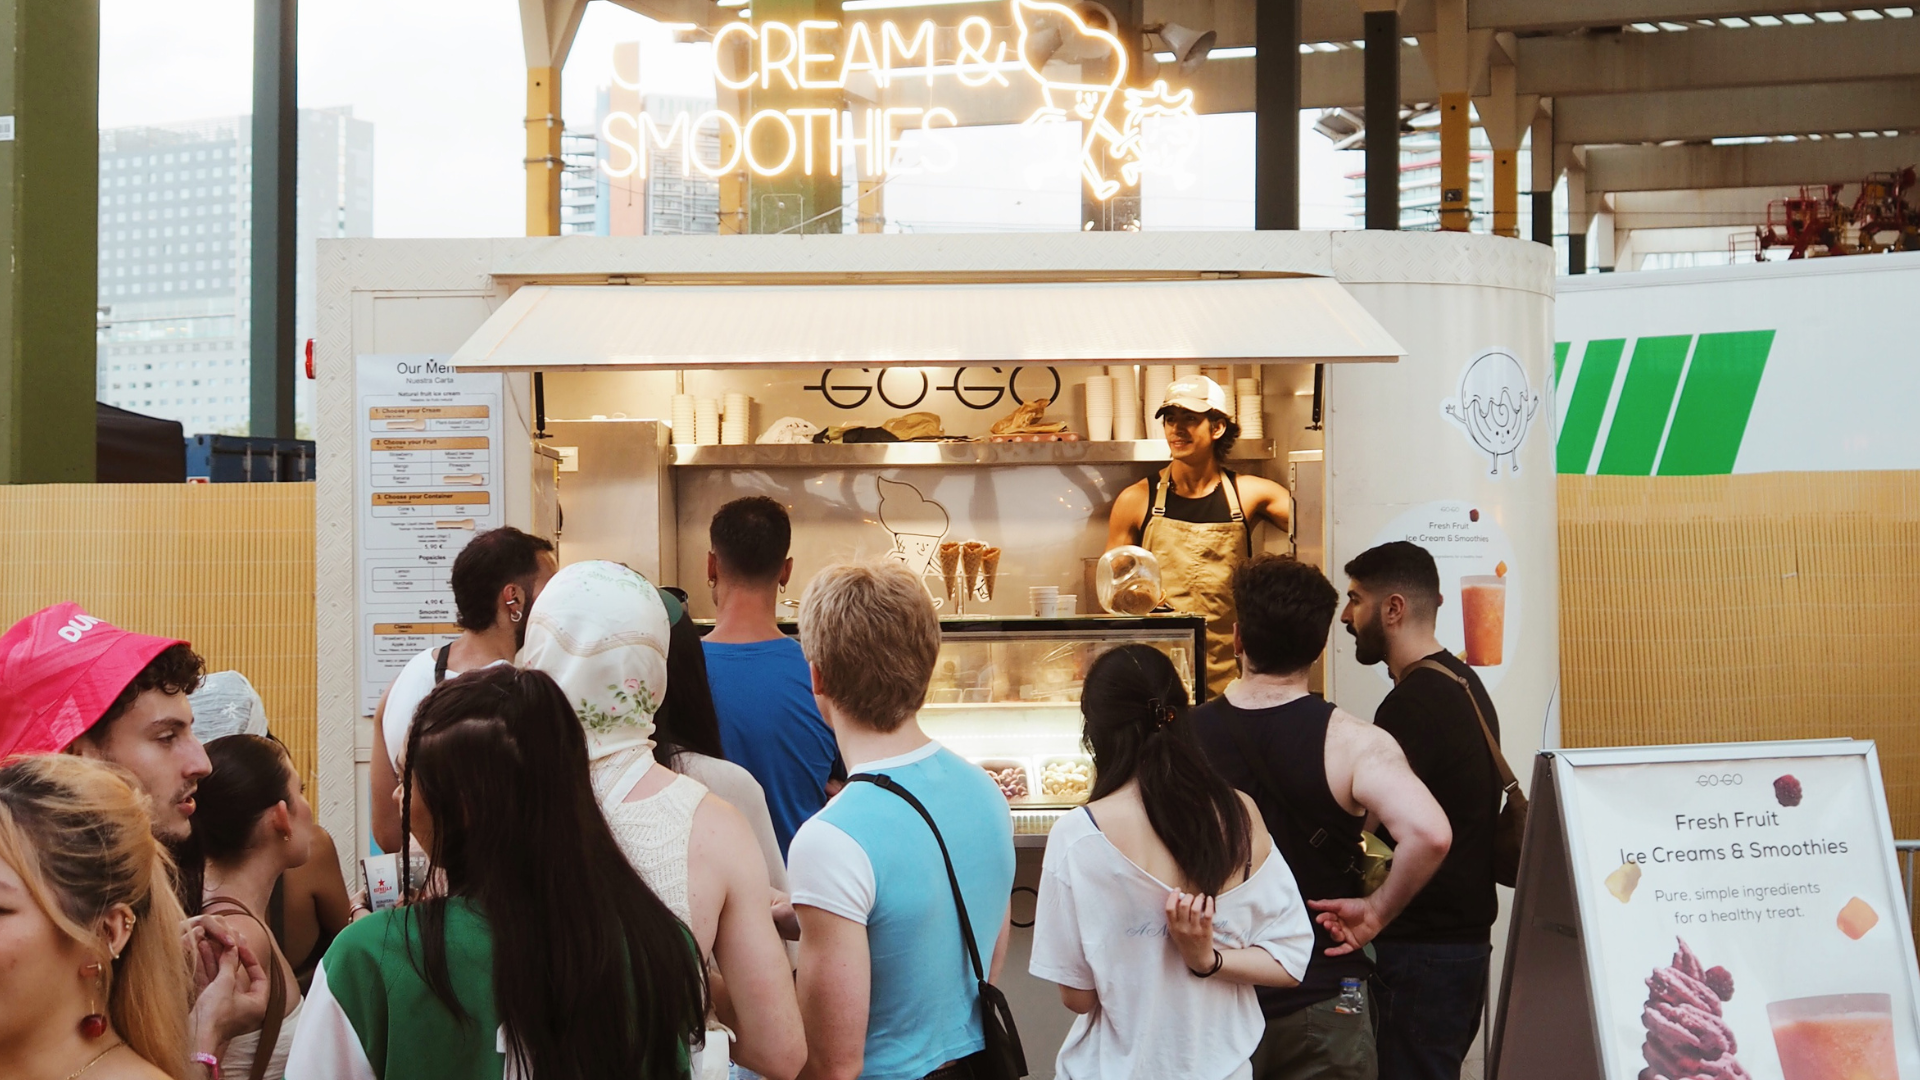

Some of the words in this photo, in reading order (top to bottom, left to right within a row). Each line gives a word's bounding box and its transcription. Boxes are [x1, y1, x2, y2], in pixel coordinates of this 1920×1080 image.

[711, 21, 936, 90] CREAM
[955, 16, 1010, 88] &
[601, 107, 958, 179] SMOOTHIES
[397, 362, 422, 374] Our
[426, 361, 456, 374] Men
[1428, 521, 1450, 530] Fresh
[1452, 522, 1469, 530] Fruit
[1405, 534, 1417, 542] Ice
[1419, 534, 1446, 542] Cream
[1447, 534, 1453, 542] &
[1454, 534, 1489, 543] Smoothies
[1675, 812, 1729, 831] Fresh
[1734, 810, 1780, 829] Fruit
[1620, 848, 1647, 865] Ice
[1652, 845, 1726, 864] Creams
[1731, 843, 1744, 859] &
[1750, 838, 1848, 859] Smoothies
[1655, 888, 1692, 903] Pure,
[1695, 886, 1740, 903] simple
[1742, 881, 1821, 902] ingredients
[1674, 911, 1694, 925] for
[1699, 914, 1708, 924] a
[1711, 907, 1762, 926] healthy
[1766, 905, 1805, 920] treat.
